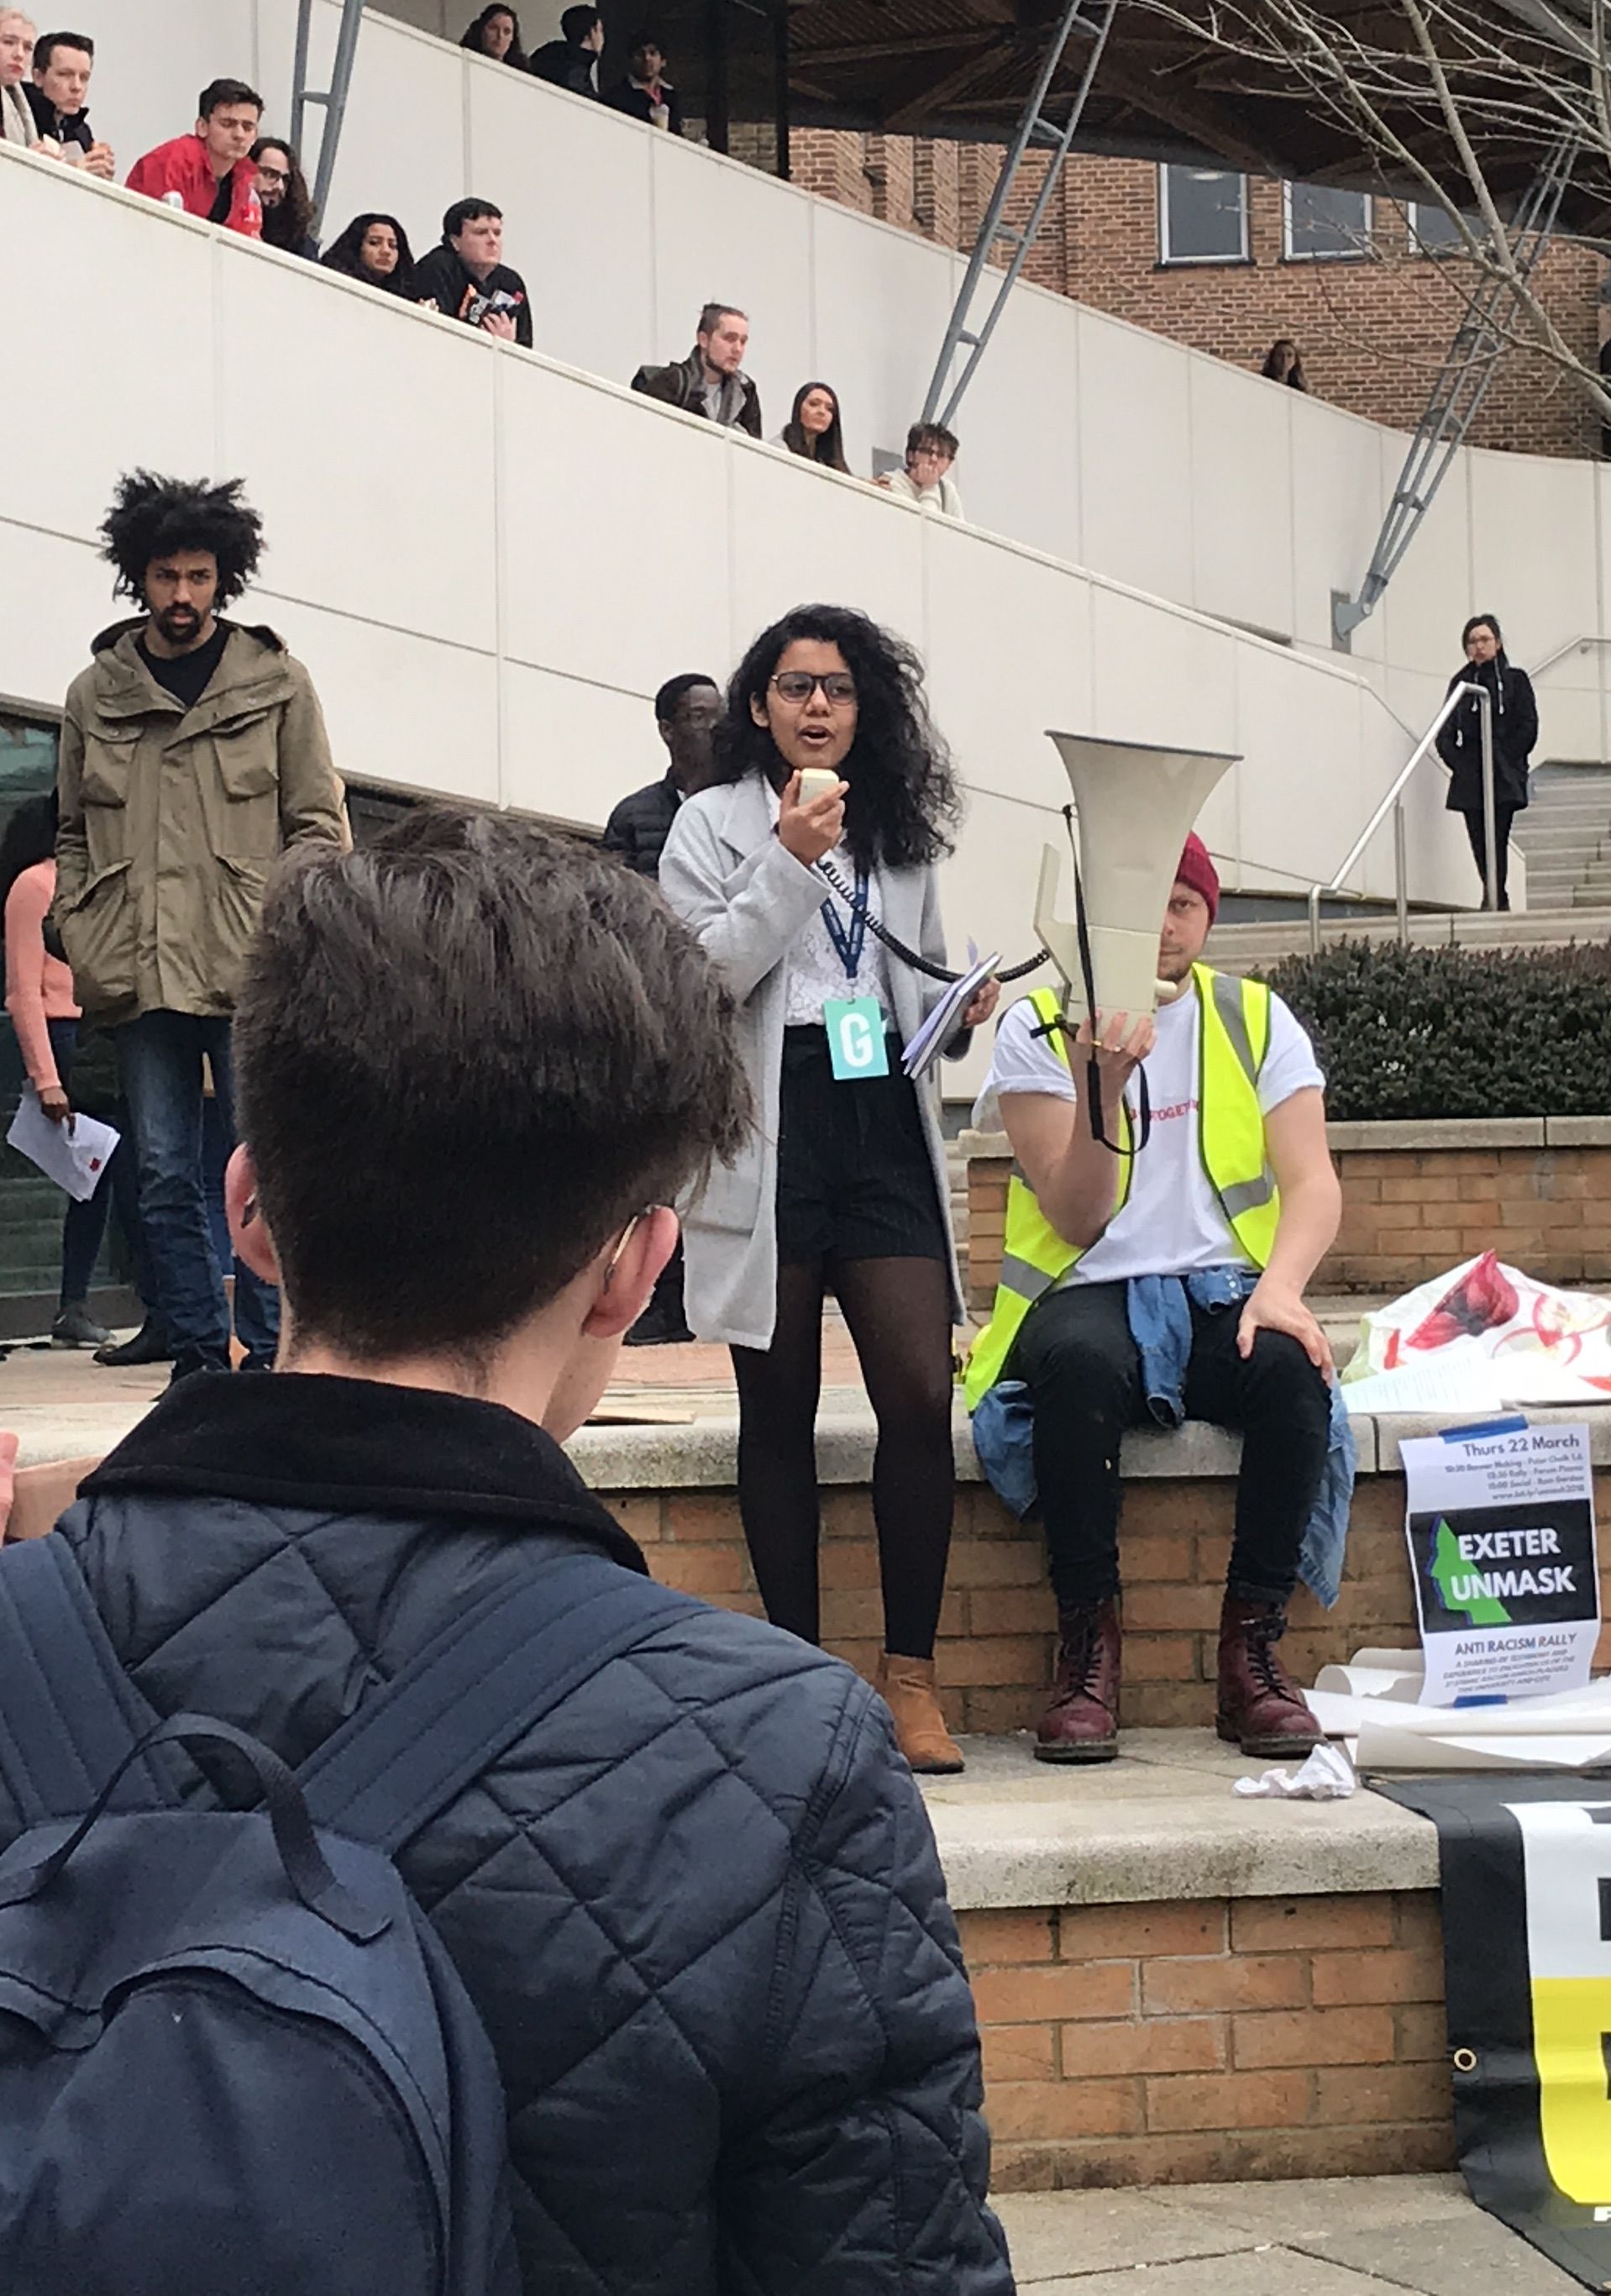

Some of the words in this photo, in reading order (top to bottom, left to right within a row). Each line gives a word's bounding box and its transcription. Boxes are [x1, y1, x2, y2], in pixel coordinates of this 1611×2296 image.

[839, 1012, 874, 1068] G
[1462, 1443, 1505, 1458] Thurs
[1508, 1437, 1529, 1453] 22
[1532, 1433, 1580, 1450] March
[1458, 1527, 1561, 1561] EXETER
[1451, 1565, 1577, 1601] UNMASK
[1454, 1642, 1485, 1655] ANTI
[1488, 1637, 1536, 1652] RACISM
[1538, 1632, 1577, 1647] RALLY
